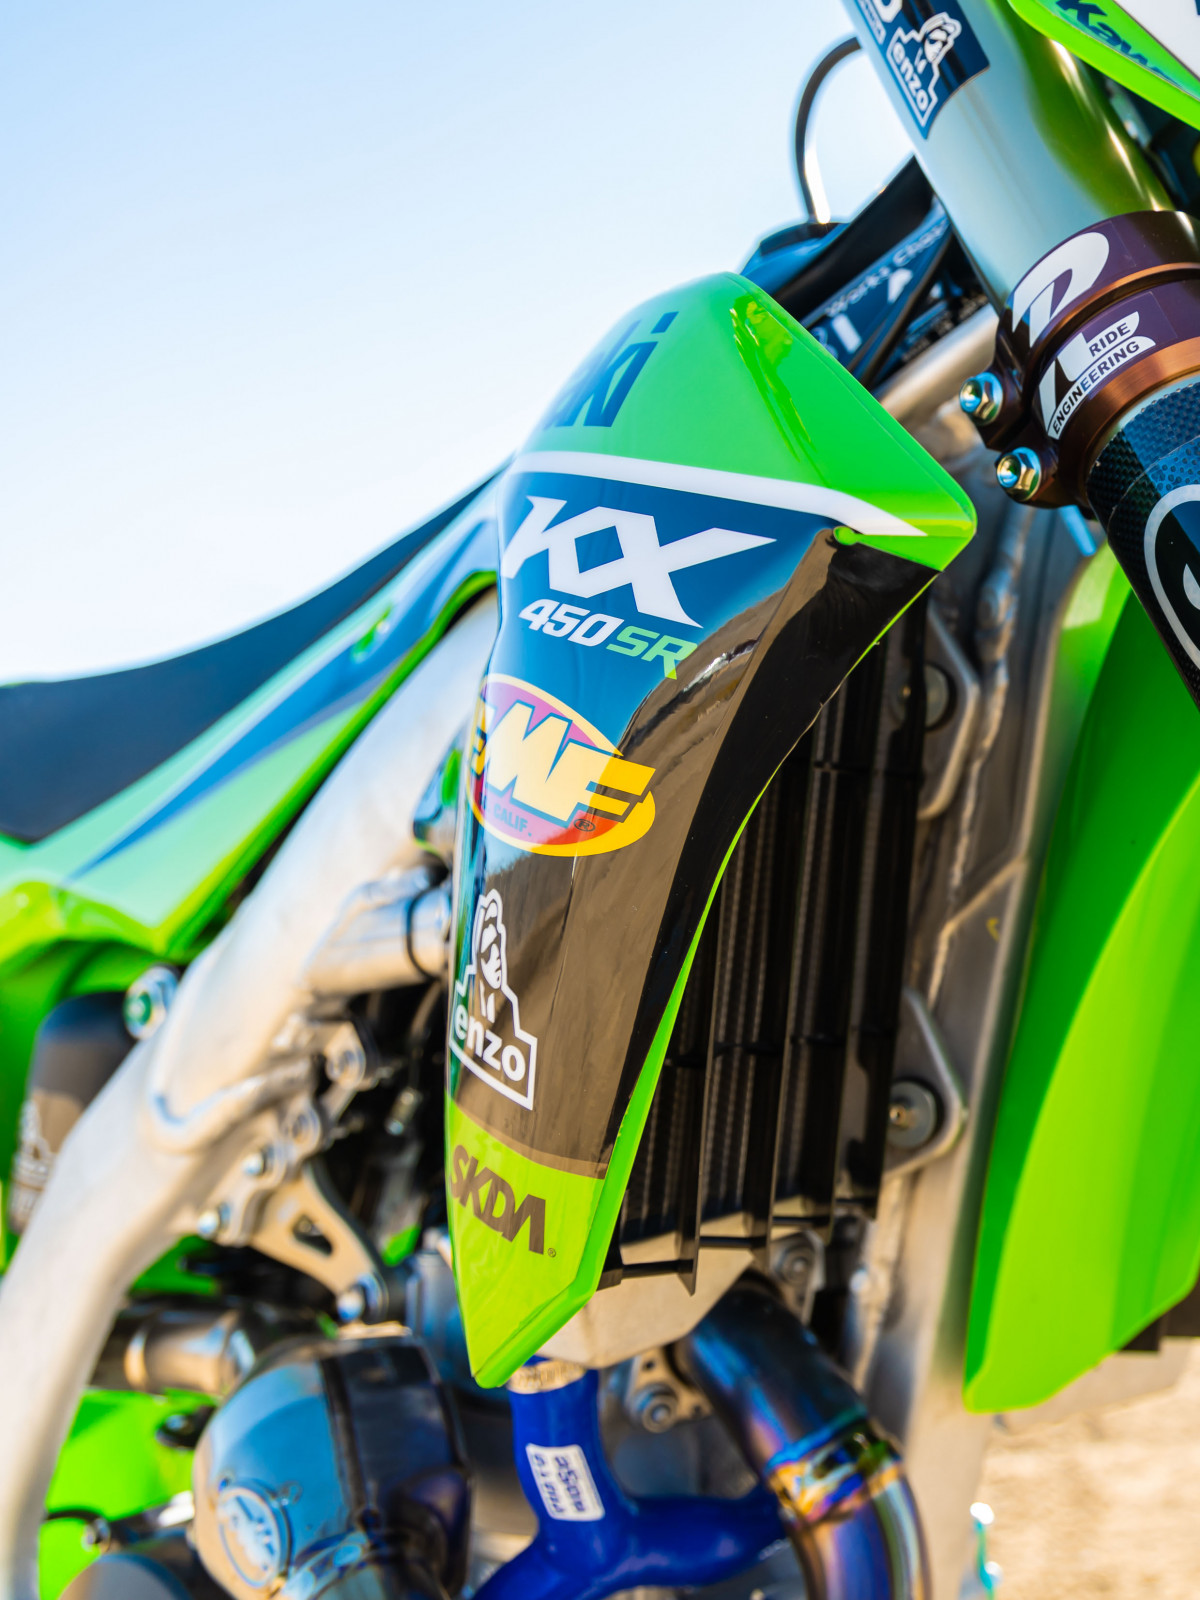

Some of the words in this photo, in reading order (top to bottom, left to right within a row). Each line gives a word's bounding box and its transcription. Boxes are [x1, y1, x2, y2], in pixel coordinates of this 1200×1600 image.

[893, 42, 929, 111] enzo
[1088, 322, 1131, 357] RIDE
[1052, 340, 1140, 435] ENGINEERING
[501, 495, 778, 629] KX
[455, 1004, 526, 1082] enzo
